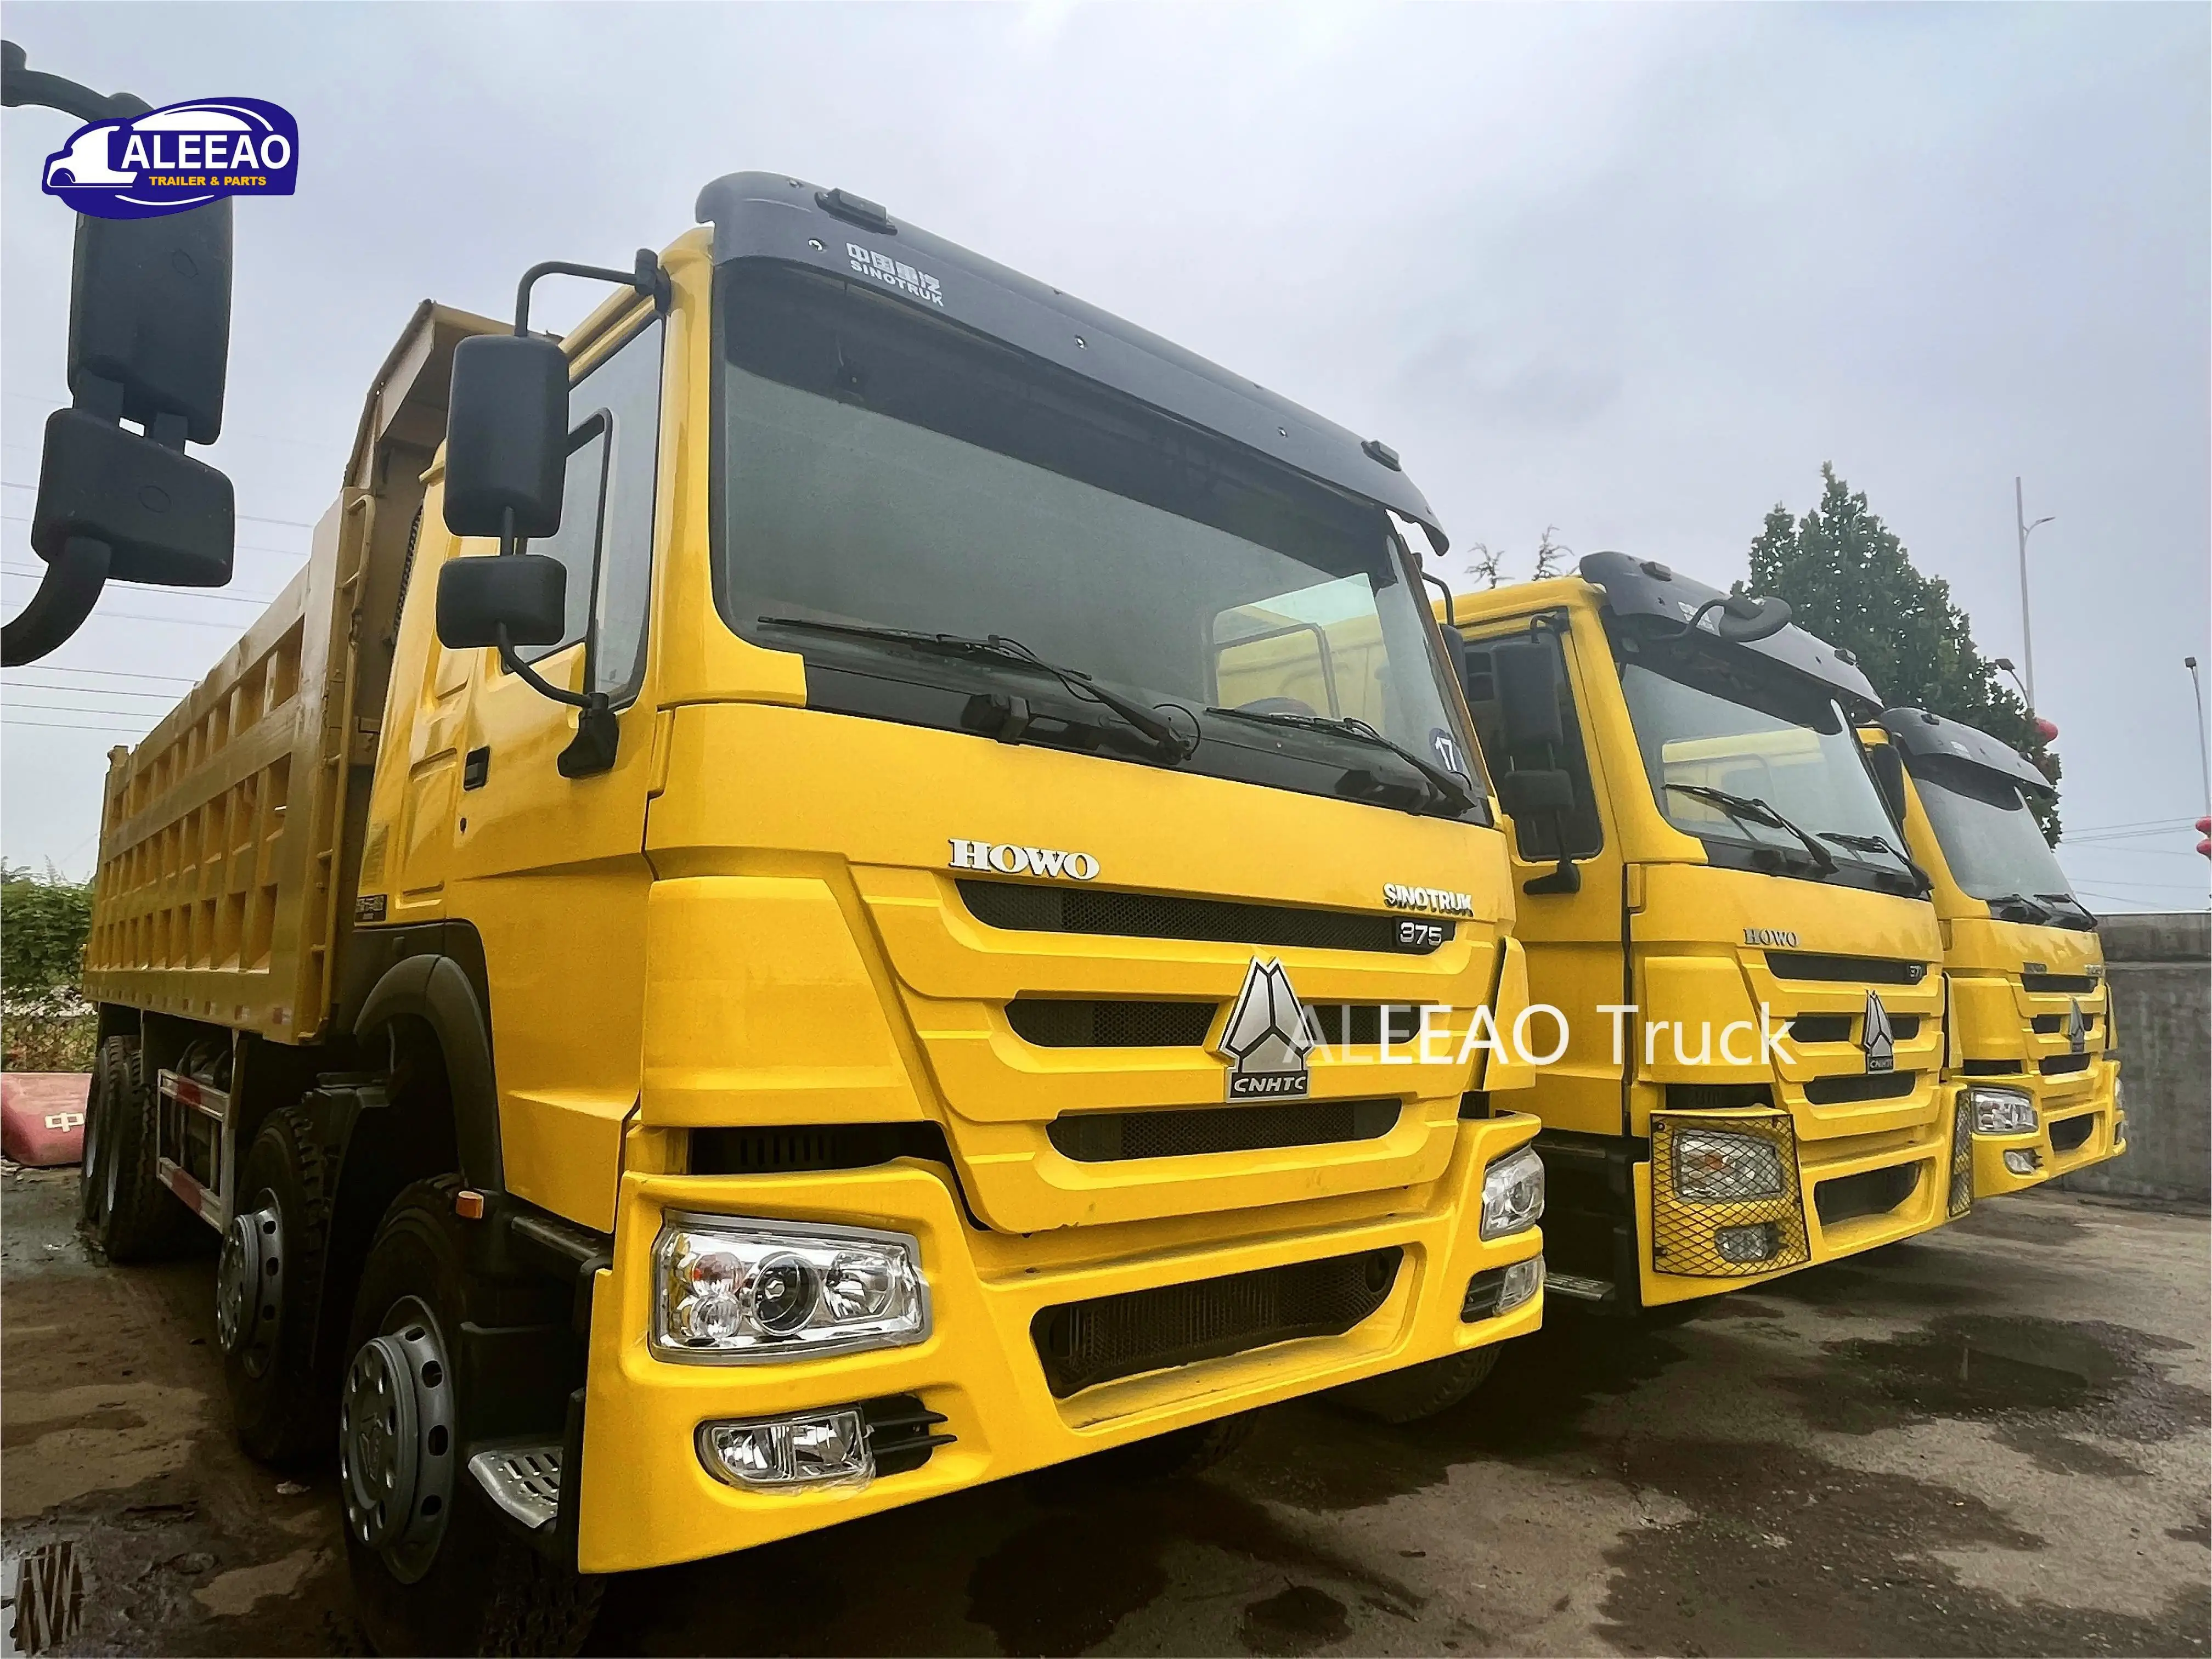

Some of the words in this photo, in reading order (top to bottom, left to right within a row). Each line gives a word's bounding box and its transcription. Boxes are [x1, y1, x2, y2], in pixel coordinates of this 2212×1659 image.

[850, 260, 944, 307] SINOTRUK
[1435, 736, 1458, 771] 17
[948, 838, 1100, 881] HOWO
[1383, 882, 1473, 915] SINOTRUK
[1400, 922, 1443, 946] 375
[1743, 928, 1798, 948] HOWO
[1234, 1076, 1307, 1093] CNHTC
[44, 1112, 84, 1132] 中
